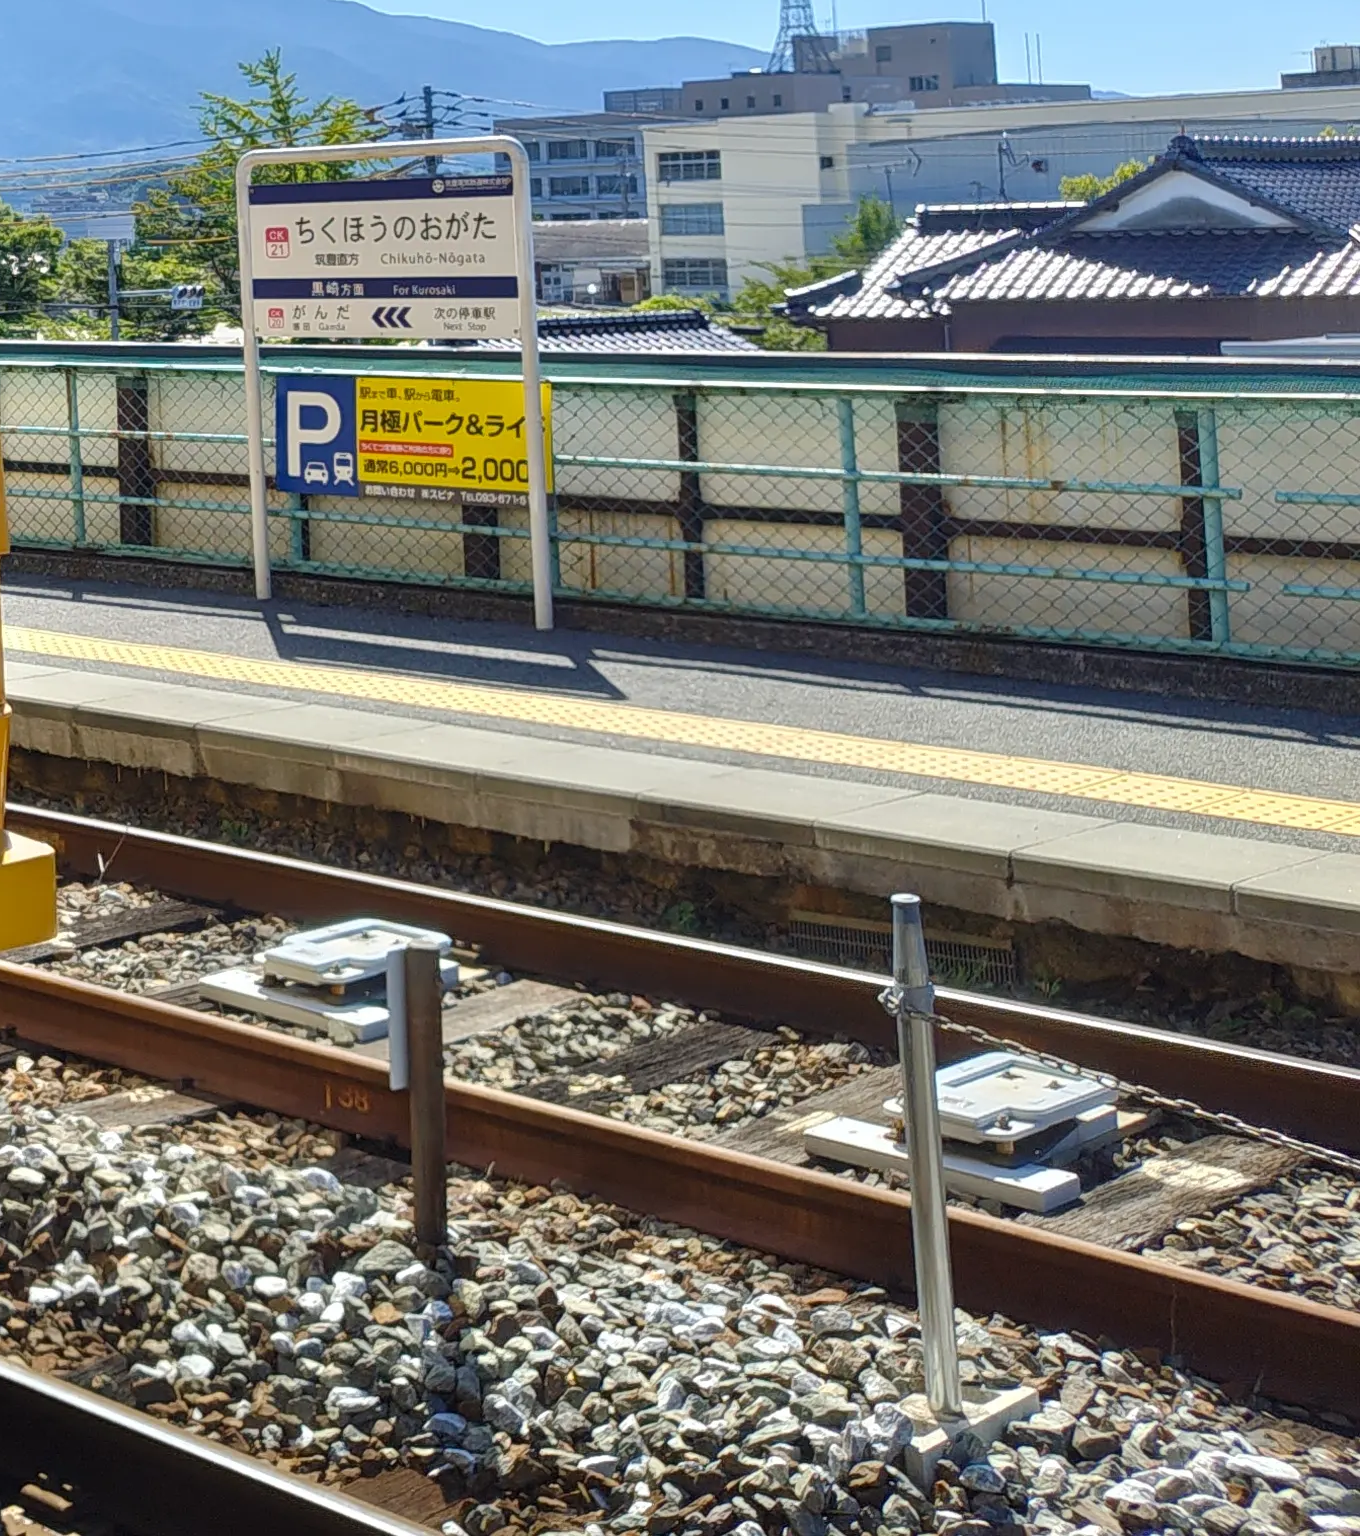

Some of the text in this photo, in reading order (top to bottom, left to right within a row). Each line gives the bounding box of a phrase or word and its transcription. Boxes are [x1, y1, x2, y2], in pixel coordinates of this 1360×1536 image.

[294, 211, 497, 244] ちくほうのおがた
[268, 231, 285, 241] CK
[271, 244, 284, 256] 21
[314, 253, 360, 266] 筑豊直方
[311, 281, 365, 297] 黒崎方面
[393, 284, 456, 296] For Kurosaki
[292, 304, 350, 320] がんだ
[434, 306, 496, 320] 次の停車駅
[443, 322, 487, 333] Next Stop
[359, 408, 546, 439] 月極パーク&ライ
[364, 485, 416, 498] お問い合わせ
